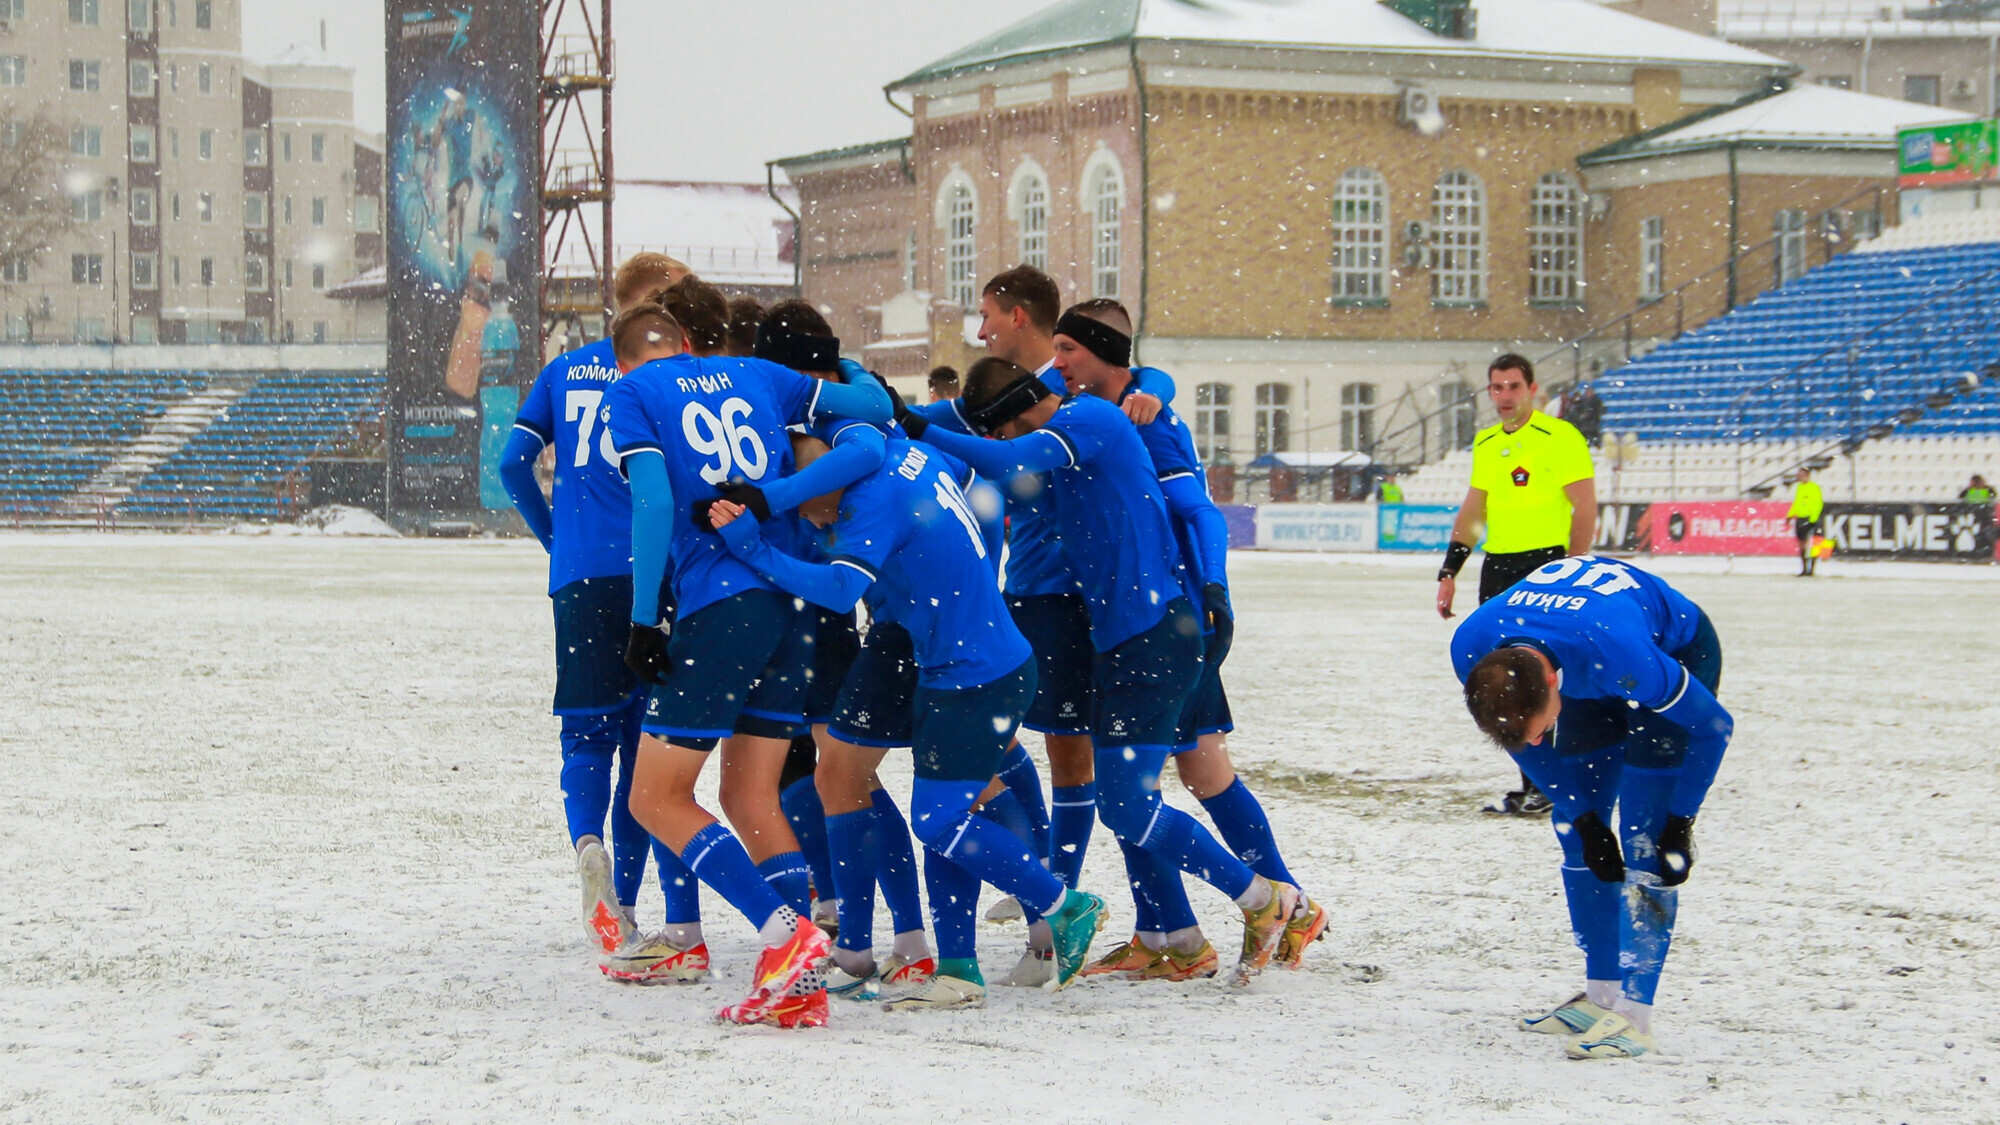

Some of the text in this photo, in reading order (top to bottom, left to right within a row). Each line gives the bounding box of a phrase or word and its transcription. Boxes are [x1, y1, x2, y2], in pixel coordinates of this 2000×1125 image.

[565, 365, 623, 384] КОММУ
[682, 397, 768, 486] 96
[1824, 514, 1950, 550] KELME
[1506, 590, 1588, 611] БАКАЙ
[850, 720, 871, 729] KELME
